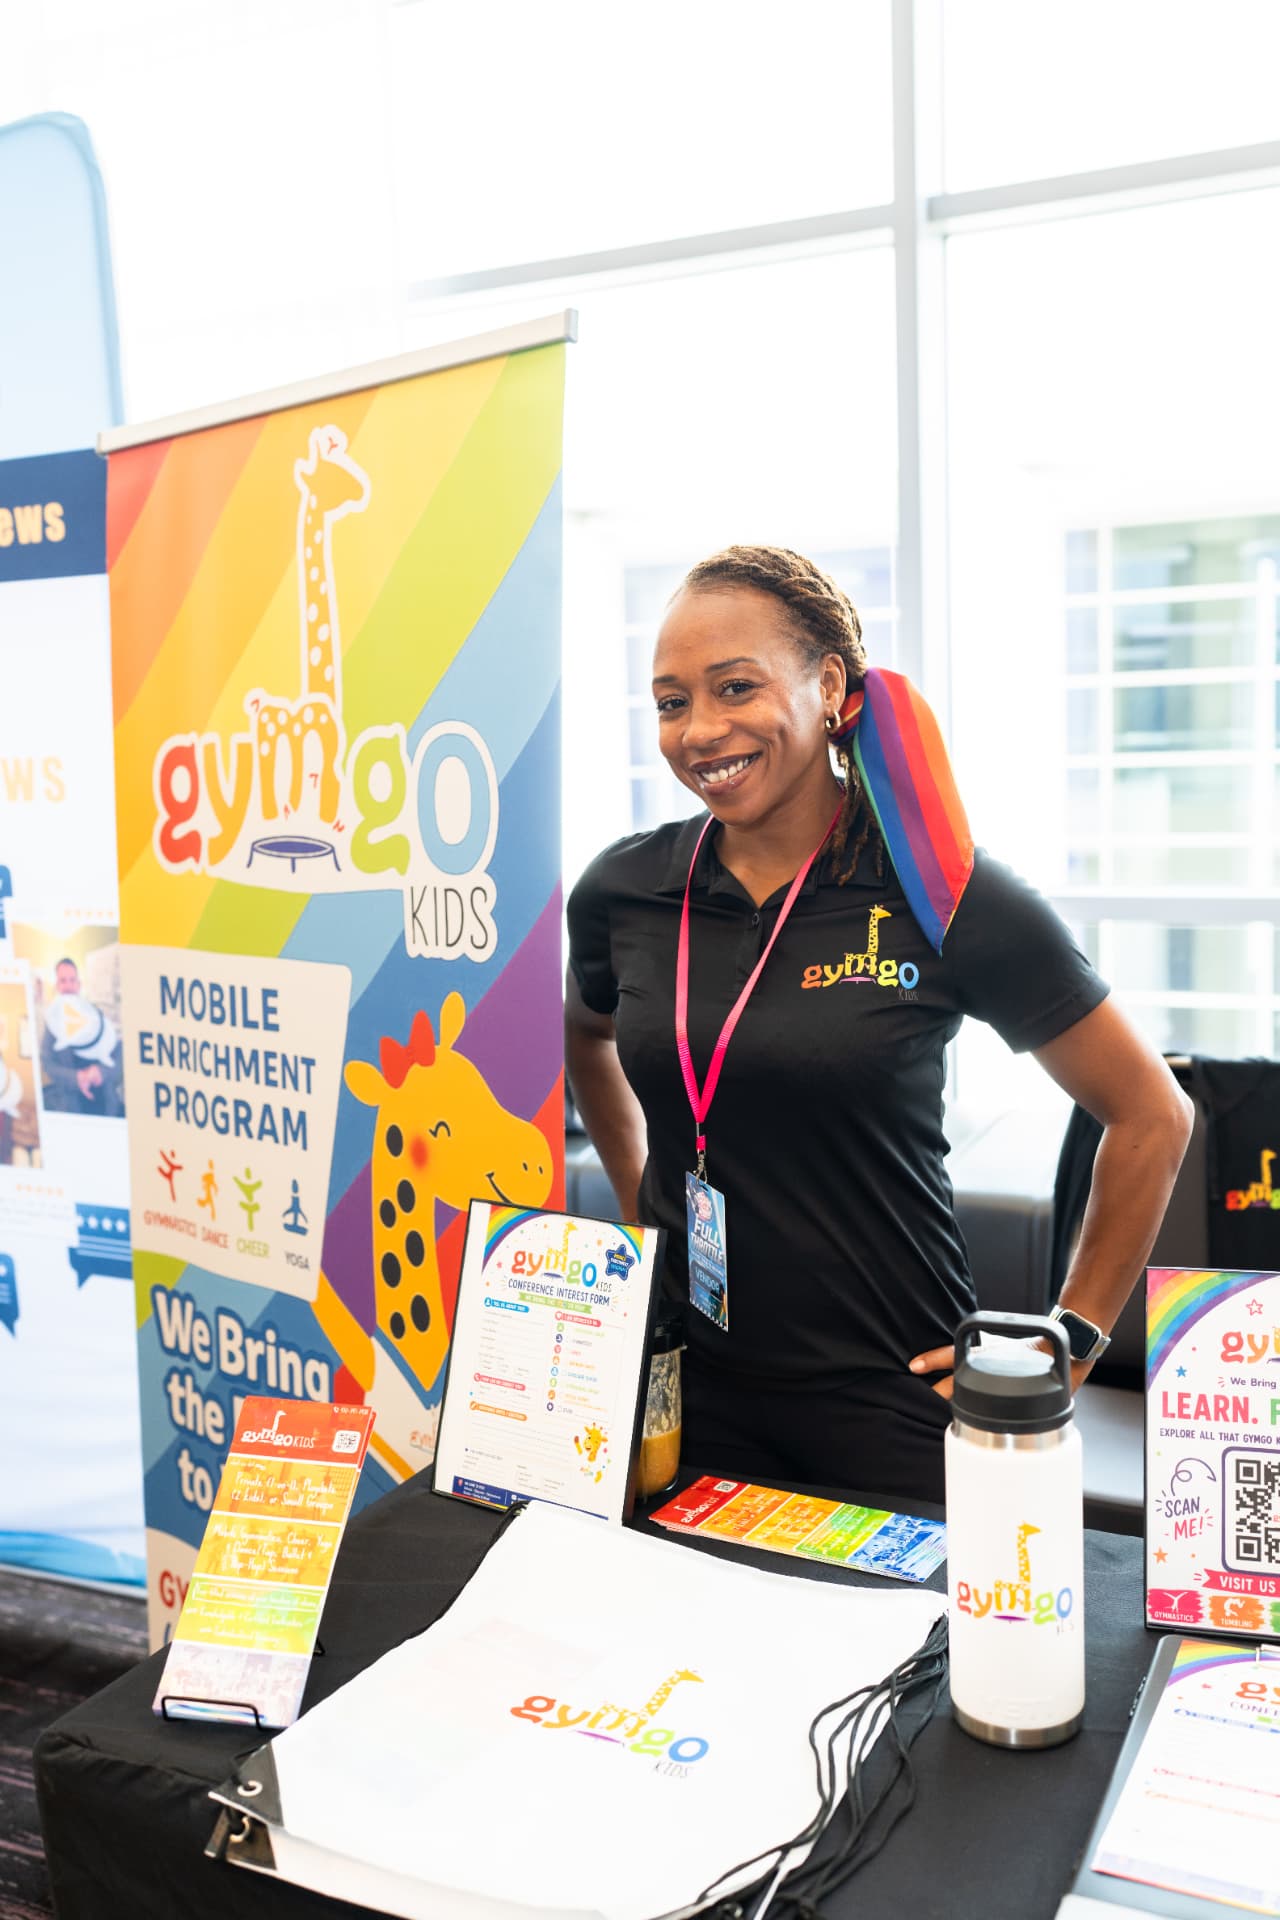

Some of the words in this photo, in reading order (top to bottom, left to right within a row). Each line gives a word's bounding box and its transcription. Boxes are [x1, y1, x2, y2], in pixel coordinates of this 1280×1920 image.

[410, 884, 490, 950] KIDS
[159, 975, 281, 1032] MOBILE
[139, 1031, 316, 1095] ENRICHMENT
[154, 1082, 309, 1151] PROGRAM
[201, 1226, 229, 1249] DANCE
[695, 1218, 720, 1248] FULL
[236, 1238, 270, 1258] CHEER
[284, 1251, 311, 1270] YOGA
[508, 1278, 554, 1297] CONFERENCE
[556, 1287, 588, 1303] INTEREST
[589, 1294, 610, 1307] FORM
[695, 1267, 720, 1296] VENDOR
[156, 1292, 212, 1364] We
[218, 1312, 330, 1404] Bring
[1230, 1377, 1246, 1386] We
[1250, 1378, 1277, 1390] Bring
[168, 1373, 224, 1445] the
[1162, 1391, 1259, 1424] LEARN.
[293, 1437, 316, 1448] KIDS
[1160, 1427, 1195, 1439] EXPLORE
[1200, 1431, 1215, 1441] ALL
[1219, 1432, 1239, 1442] THAT
[1243, 1434, 1272, 1444] GYMGO
[178, 1449, 212, 1511] to
[1165, 1496, 1200, 1518] SCAN
[1174, 1516, 1204, 1541] ME!
[1220, 1576, 1253, 1591] VISIT
[1260, 1580, 1276, 1593] US
[1154, 1611, 1194, 1622] GYMNASTICS
[654, 1760, 693, 1778] KIDS
